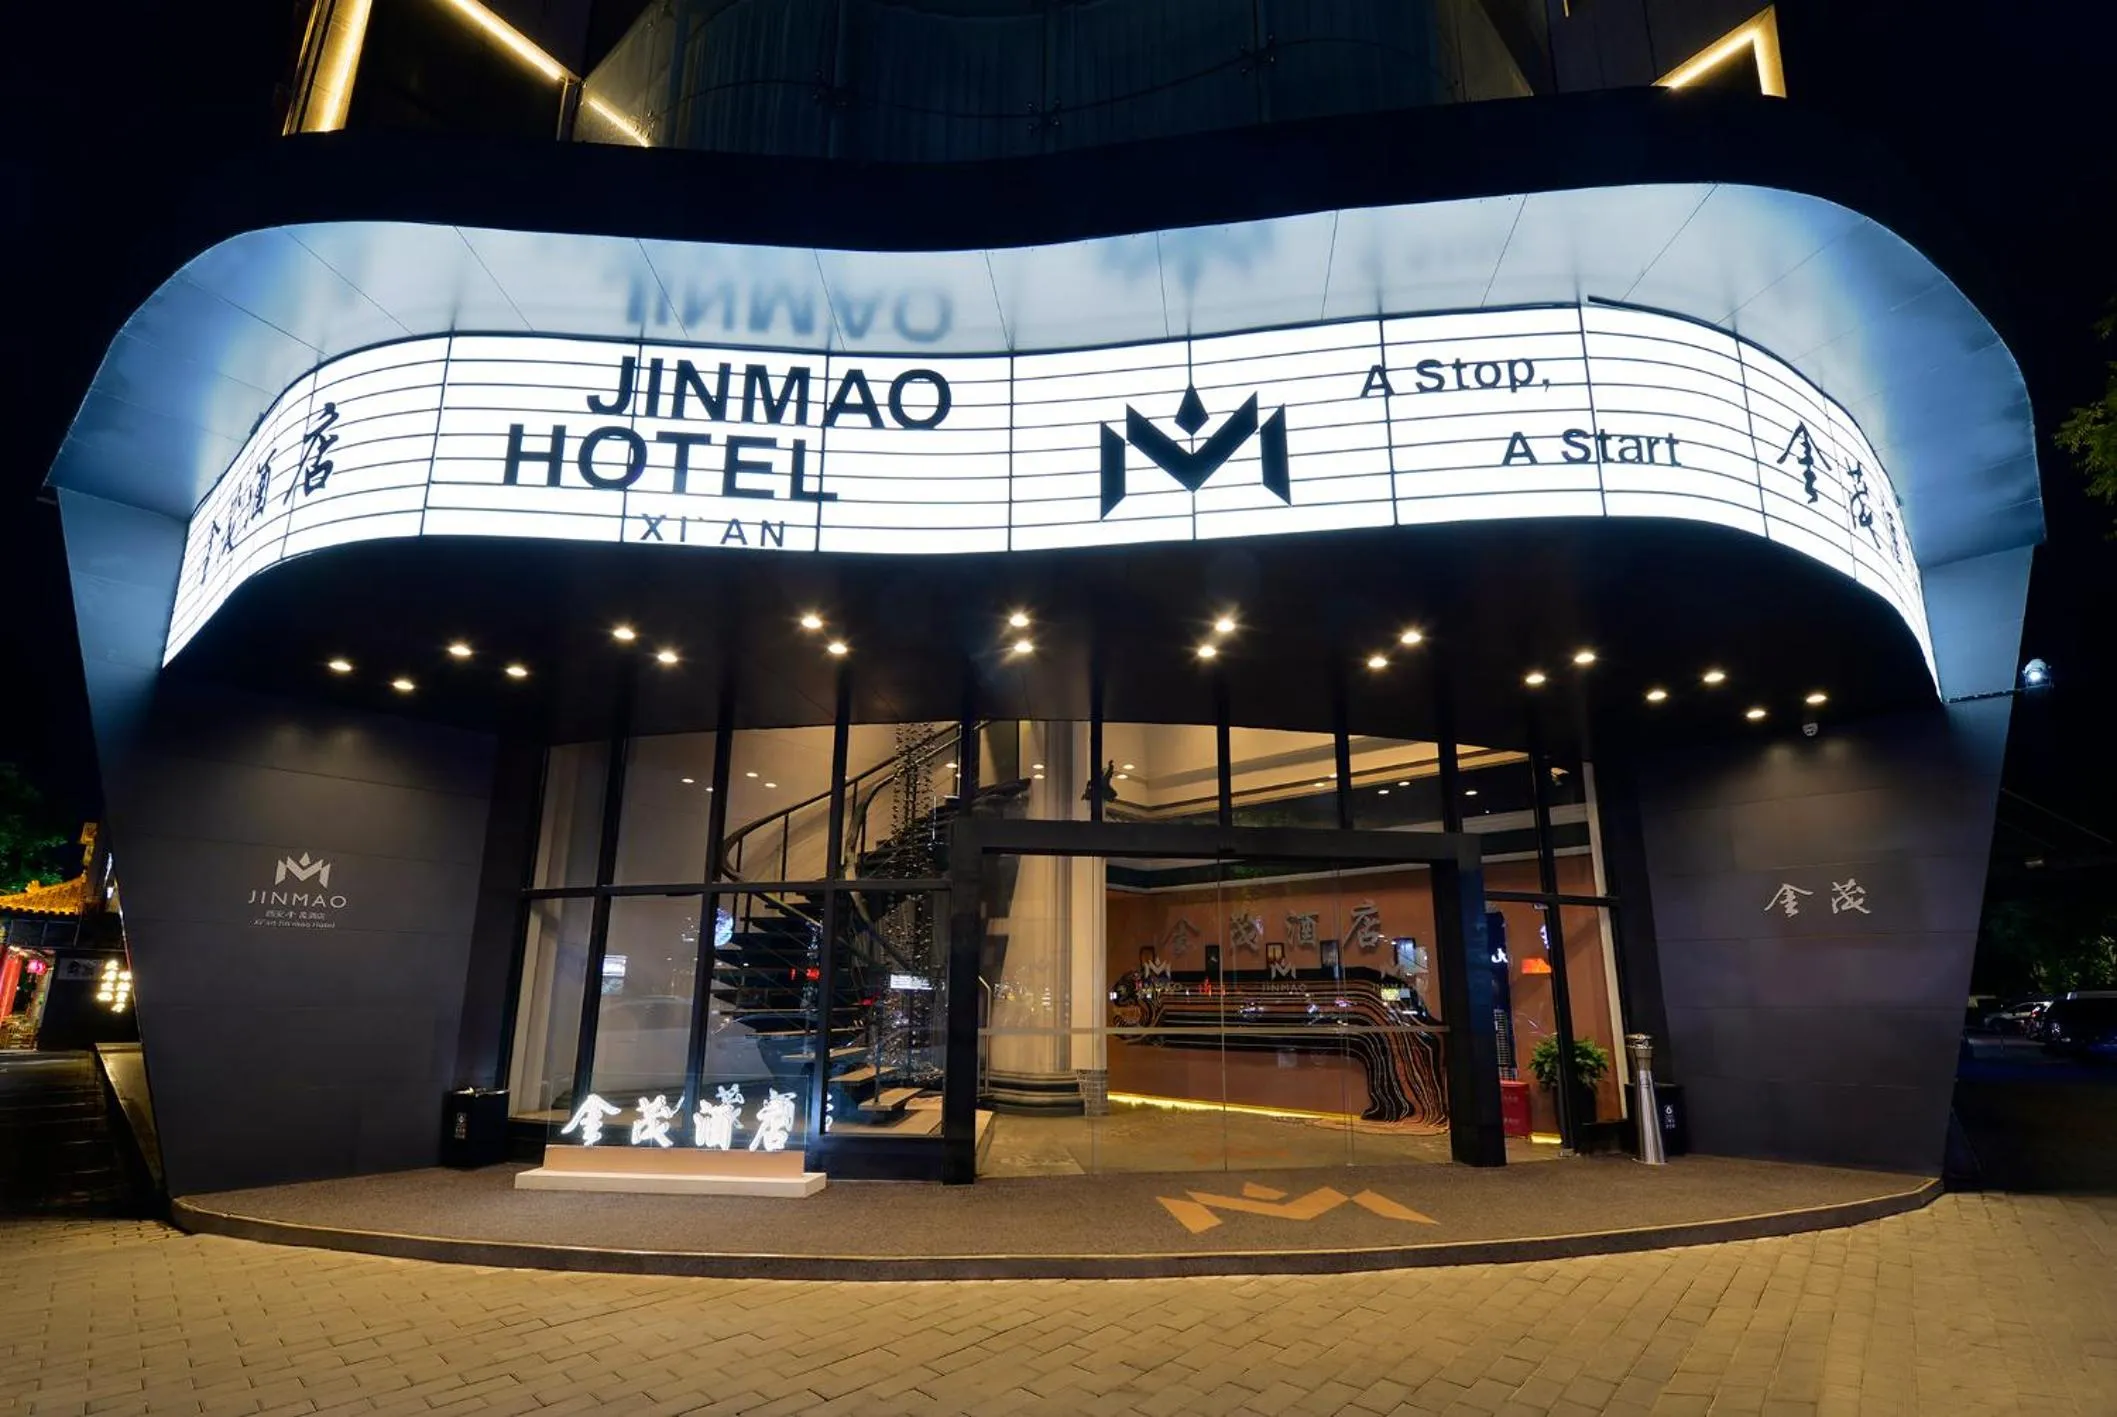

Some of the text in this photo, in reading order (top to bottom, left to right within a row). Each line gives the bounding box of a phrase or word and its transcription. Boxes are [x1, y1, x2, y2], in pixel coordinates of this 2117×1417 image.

[586, 356, 952, 429] JINMAO
[1360, 357, 1551, 398] A Stop,
[503, 424, 838, 502] HOTEL
[1502, 428, 1682, 467] A Start
[248, 890, 347, 908] JINMAO
[1764, 878, 1872, 917] 金茂
